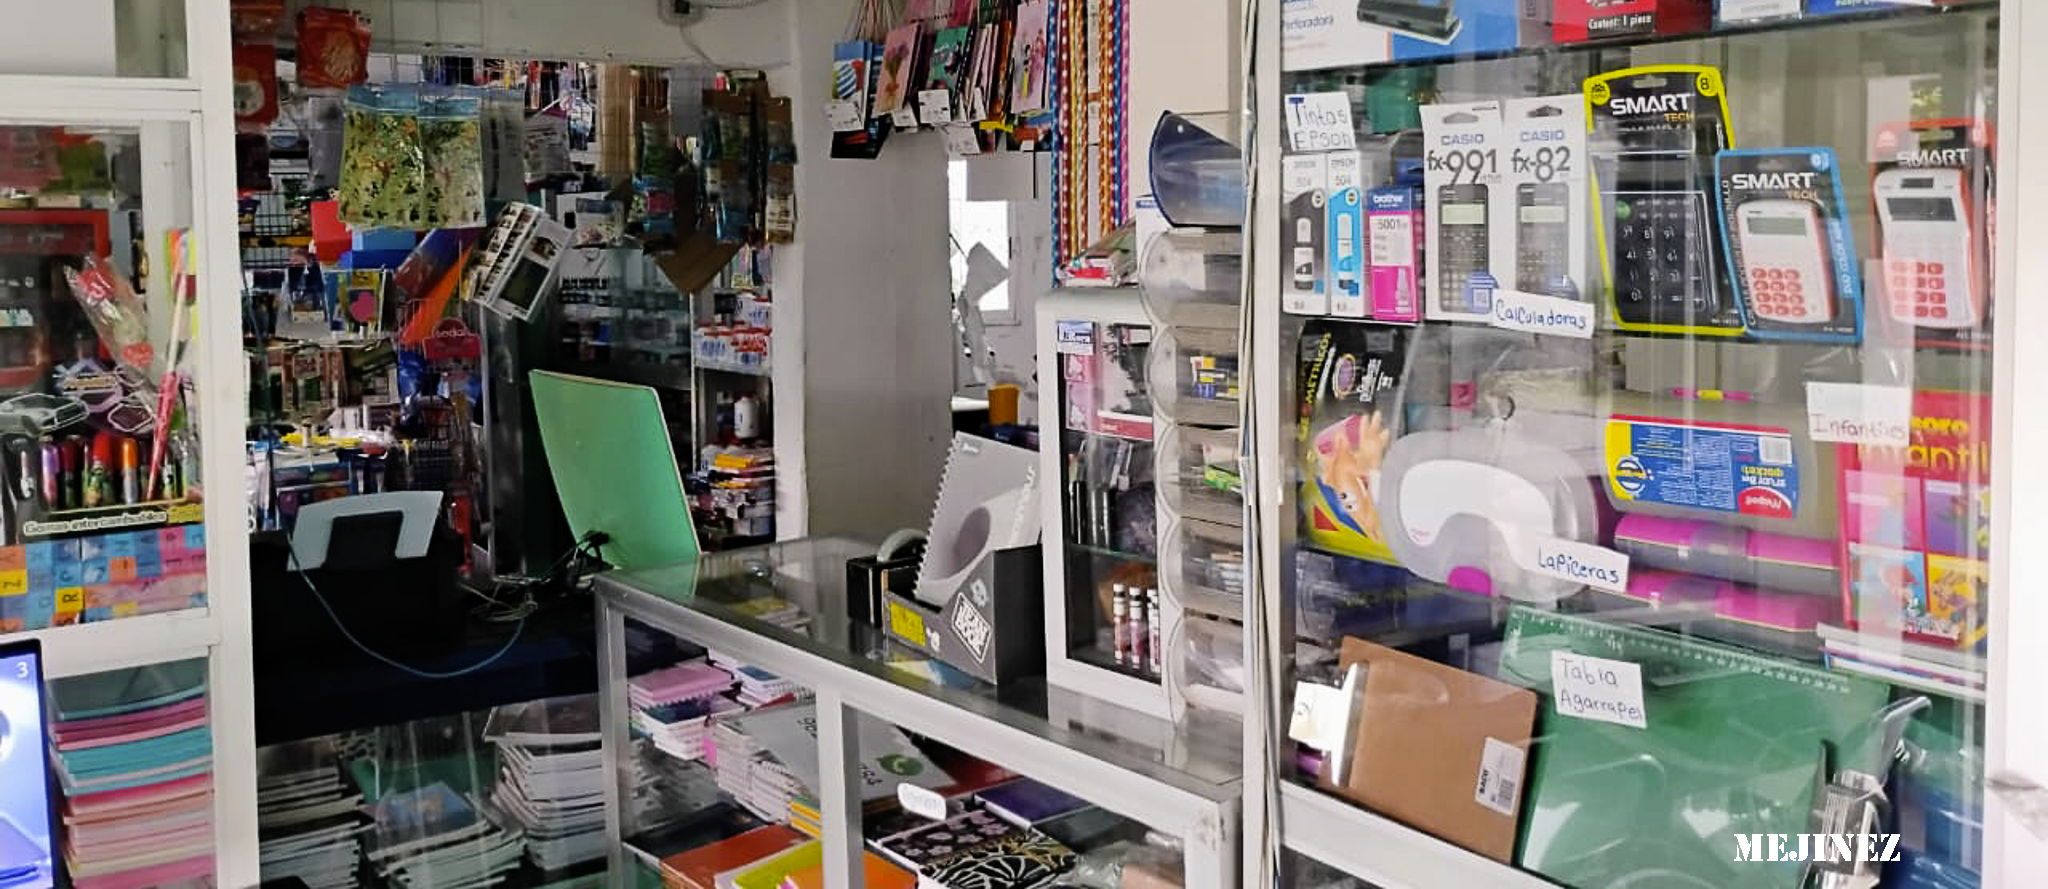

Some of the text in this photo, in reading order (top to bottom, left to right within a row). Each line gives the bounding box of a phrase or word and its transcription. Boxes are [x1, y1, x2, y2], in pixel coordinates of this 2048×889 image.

[1288, 96, 1349, 127] Tintas
[1610, 92, 1695, 116] SMART
[1664, 112, 1694, 122] TECH
[1440, 133, 1485, 146] CASIO
[1520, 129, 1566, 142] CASIO
[1427, 148, 1497, 186] fx-991
[1510, 145, 1571, 182] fx-82
[1896, 148, 1969, 169] SMART
[1731, 172, 1818, 190] SMART
